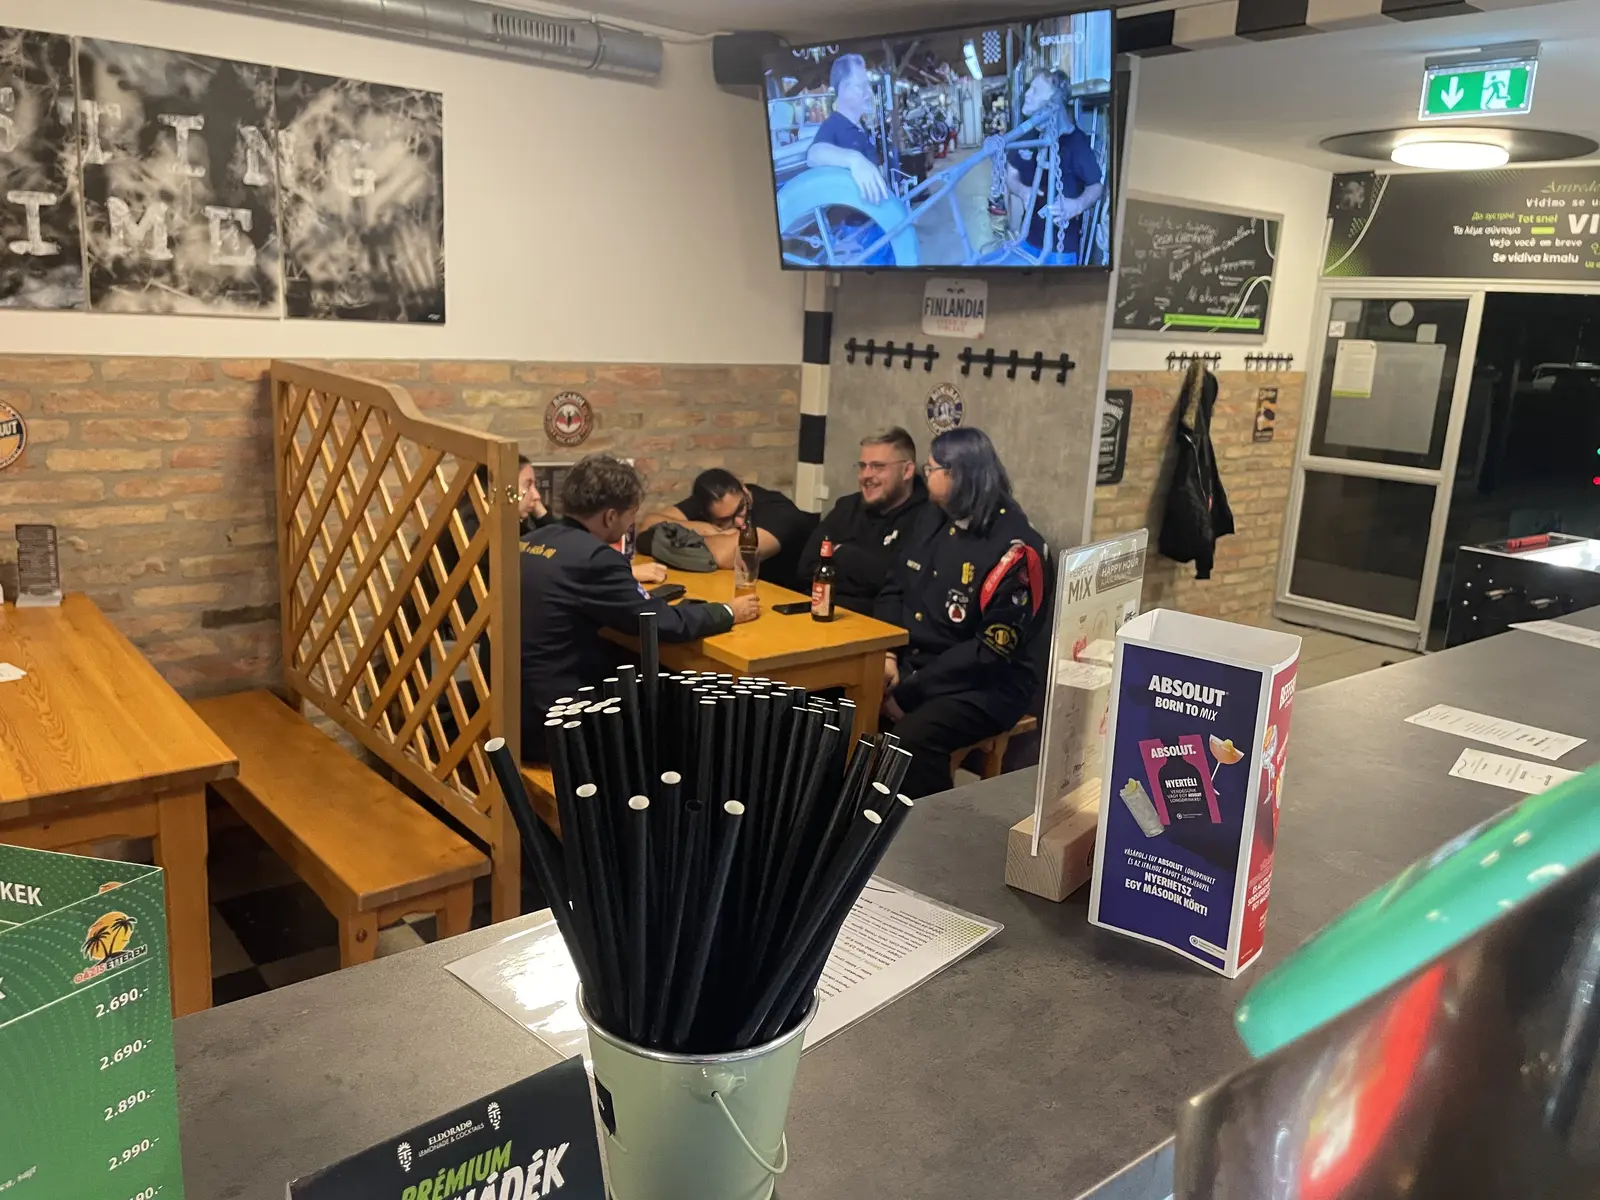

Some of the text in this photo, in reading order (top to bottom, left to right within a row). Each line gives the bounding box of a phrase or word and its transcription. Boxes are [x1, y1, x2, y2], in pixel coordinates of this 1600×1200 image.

[1526, 197, 1566, 208] Vidimo
[1572, 199, 1586, 207] se
[1518, 214, 1558, 224] Tot snel
[1490, 238, 1511, 249] Vejo
[1514, 237, 1536, 248] você
[1555, 238, 1583, 248] breve
[1492, 251, 1580, 264] Se vidiva kmalu
[924, 296, 984, 319] FINLANDIA
[1101, 557, 1139, 577] HAPPY HOUR
[1067, 575, 1093, 605] MIX
[1148, 674, 1226, 708] ABSOLUT
[1155, 696, 1219, 722] BORN TO MIX
[1165, 776, 1198, 788] NYERTÉL!
[1124, 848, 1148, 860] VÁSÁROLJ
[1148, 853, 1158, 863] EGY
[1157, 857, 1184, 872] ABSOLUT
[1134, 859, 1141, 868] AZ
[1162, 867, 1181, 880] KAPOTT
[1144, 871, 1192, 897] NYERHETSZ
[1125, 878, 1208, 917] EGY MÁSODIK KÖRT!
[74, 945, 147, 984] OÁZIS ETTEREM
[95, 987, 149, 1018] 2.690.-
[100, 1039, 152, 1071] 2.690.-
[104, 1088, 156, 1121] 2.890.-
[418, 1121, 485, 1158] LEMONADE & COCKTAILS
[428, 1119, 473, 1146] ELDORADO
[108, 1137, 160, 1171] 2.990.-
[401, 1139, 513, 1200] PRÉMIUM
